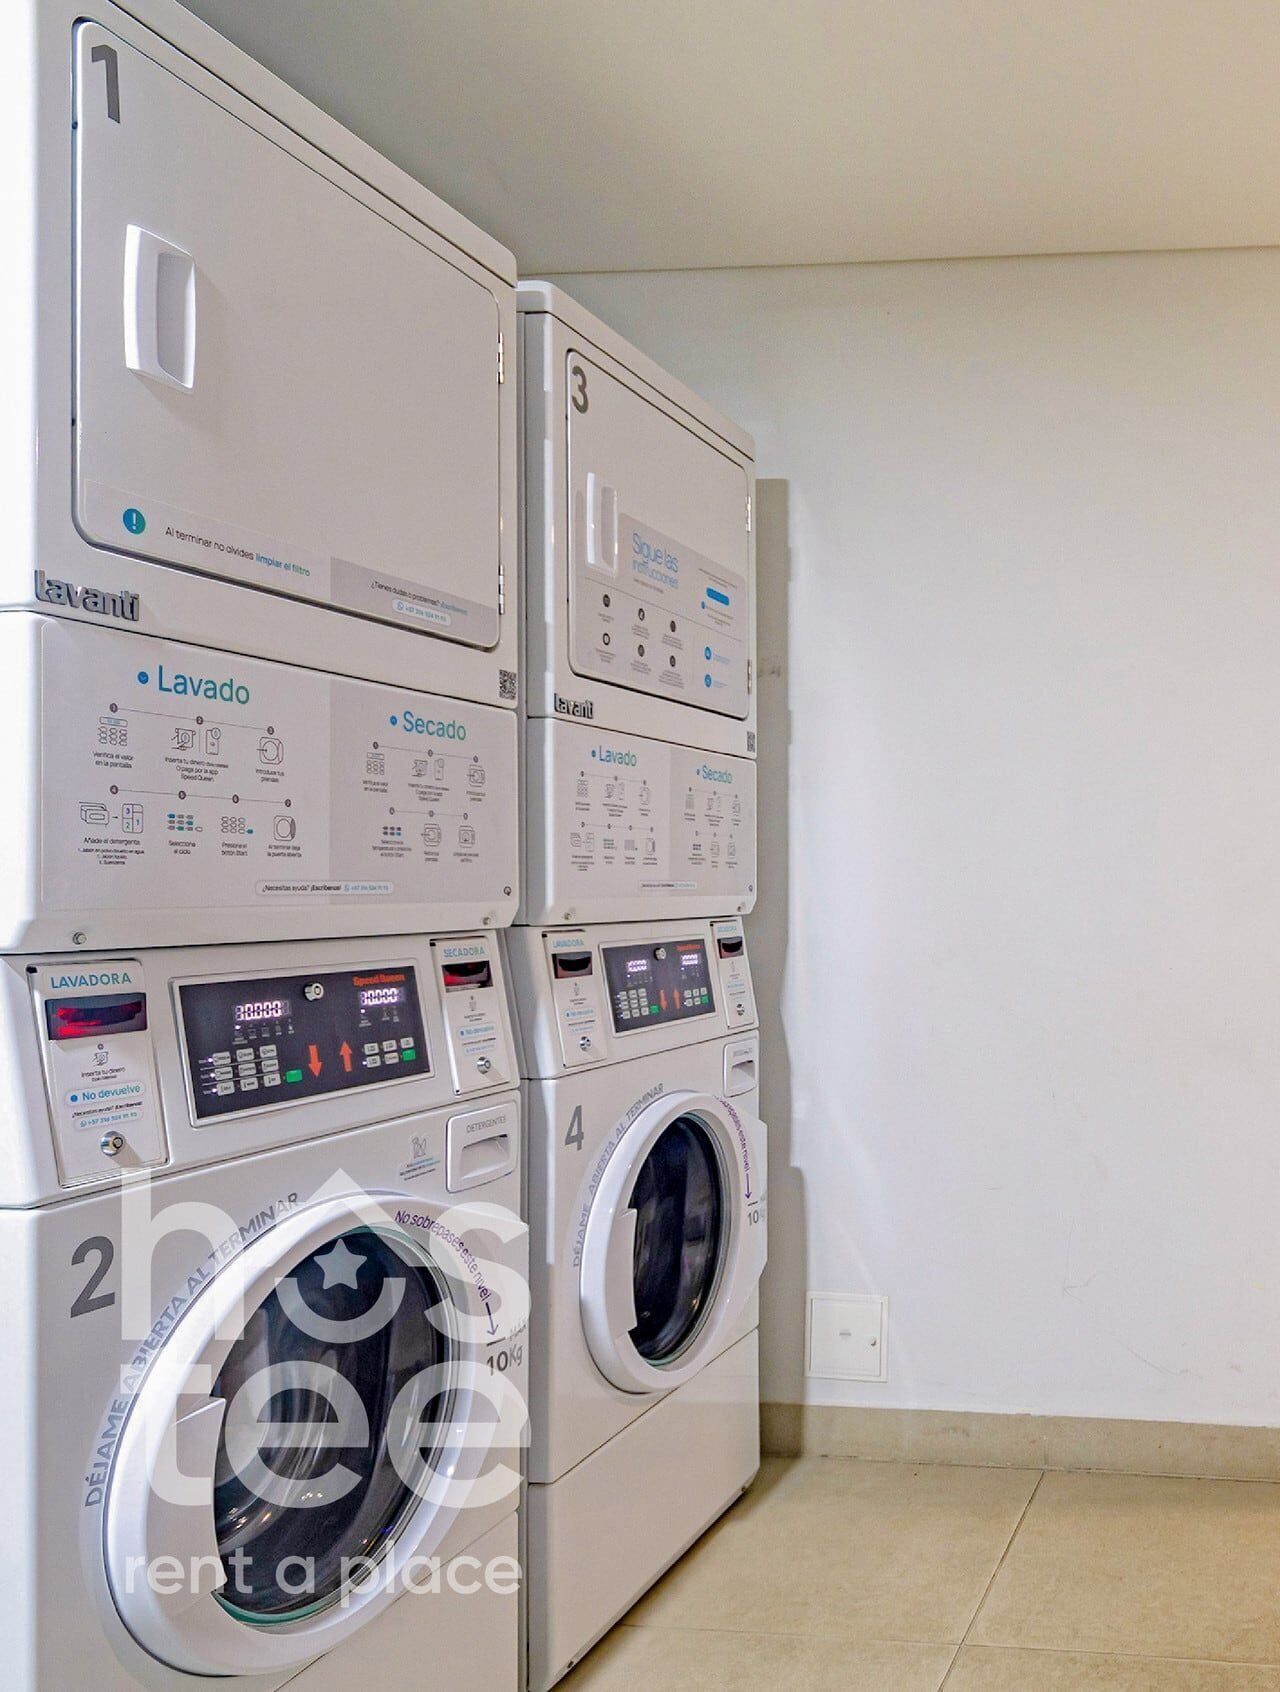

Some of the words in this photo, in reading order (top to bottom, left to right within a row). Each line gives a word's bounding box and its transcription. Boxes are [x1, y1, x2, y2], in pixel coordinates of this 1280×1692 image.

[91, 44, 120, 123] 1
[572, 365, 589, 415] 3
[165, 526, 175, 537] Al
[175, 530, 213, 548] terminar
[214, 541, 225, 552] no
[226, 544, 255, 561] olvides
[255, 552, 283, 568] limpiar
[34, 569, 141, 623] lavanti
[158, 664, 251, 705] Lavado
[402, 710, 467, 741] Secado
[554, 692, 594, 720] lavanti
[599, 745, 637, 767] Lavado
[702, 765, 733, 785] Secado
[443, 946, 486, 957] SECADORA
[51, 972, 132, 989] LAVADORA
[82, 1092, 97, 1101] No
[98, 1084, 141, 1099] devuelve
[564, 1105, 585, 1151] 4
[395, 1209, 411, 1225] No
[410, 1213, 466, 1253] sobrepases
[70, 1236, 116, 1319] 2
[84, 1398, 130, 1508] DÉJAME
[122, 1292, 189, 1392] ABIERTA
[187, 1264, 211, 1295] AL
[208, 1191, 299, 1263] TERMINAR
